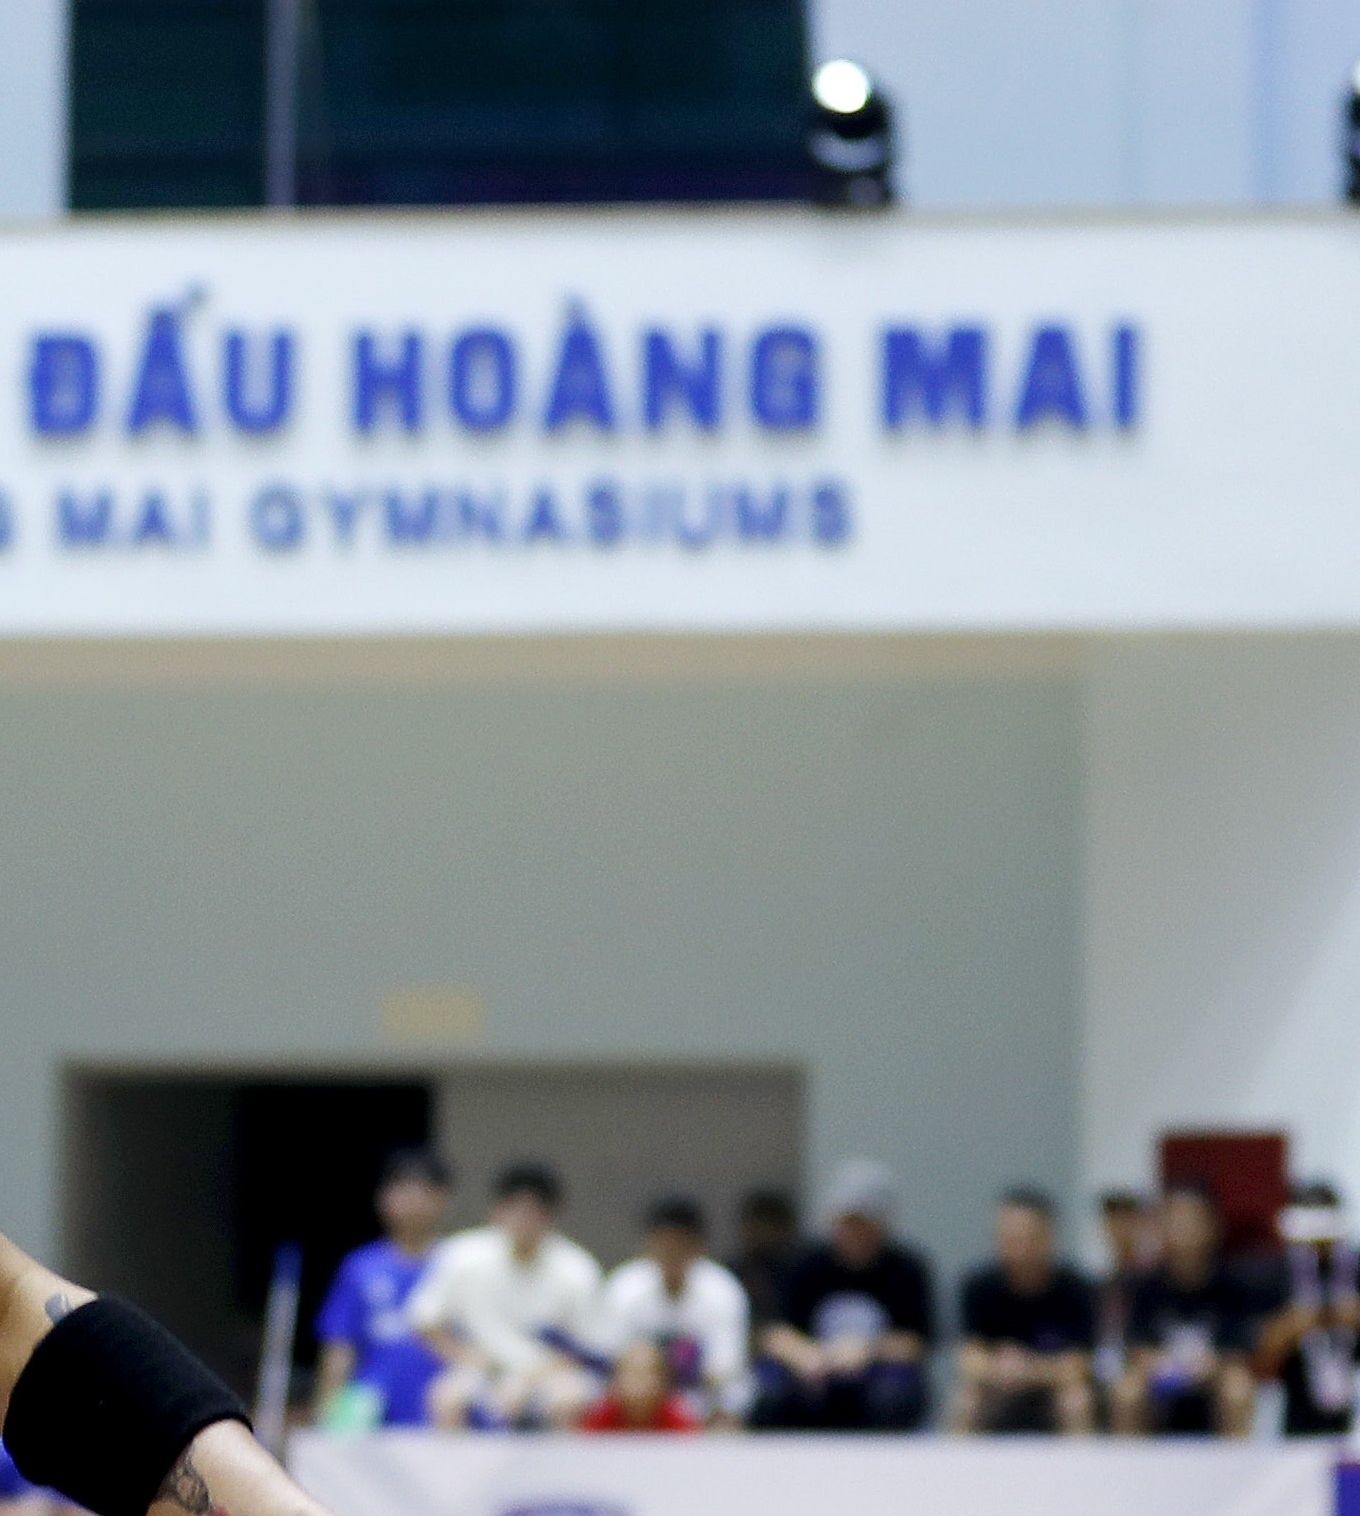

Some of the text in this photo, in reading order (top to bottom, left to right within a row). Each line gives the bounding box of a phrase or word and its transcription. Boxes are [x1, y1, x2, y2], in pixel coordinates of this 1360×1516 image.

[23, 290, 296, 442] ĐẤU
[349, 298, 823, 441] HOÀNG
[882, 325, 1141, 438] MAI
[55, 487, 211, 552] MAI
